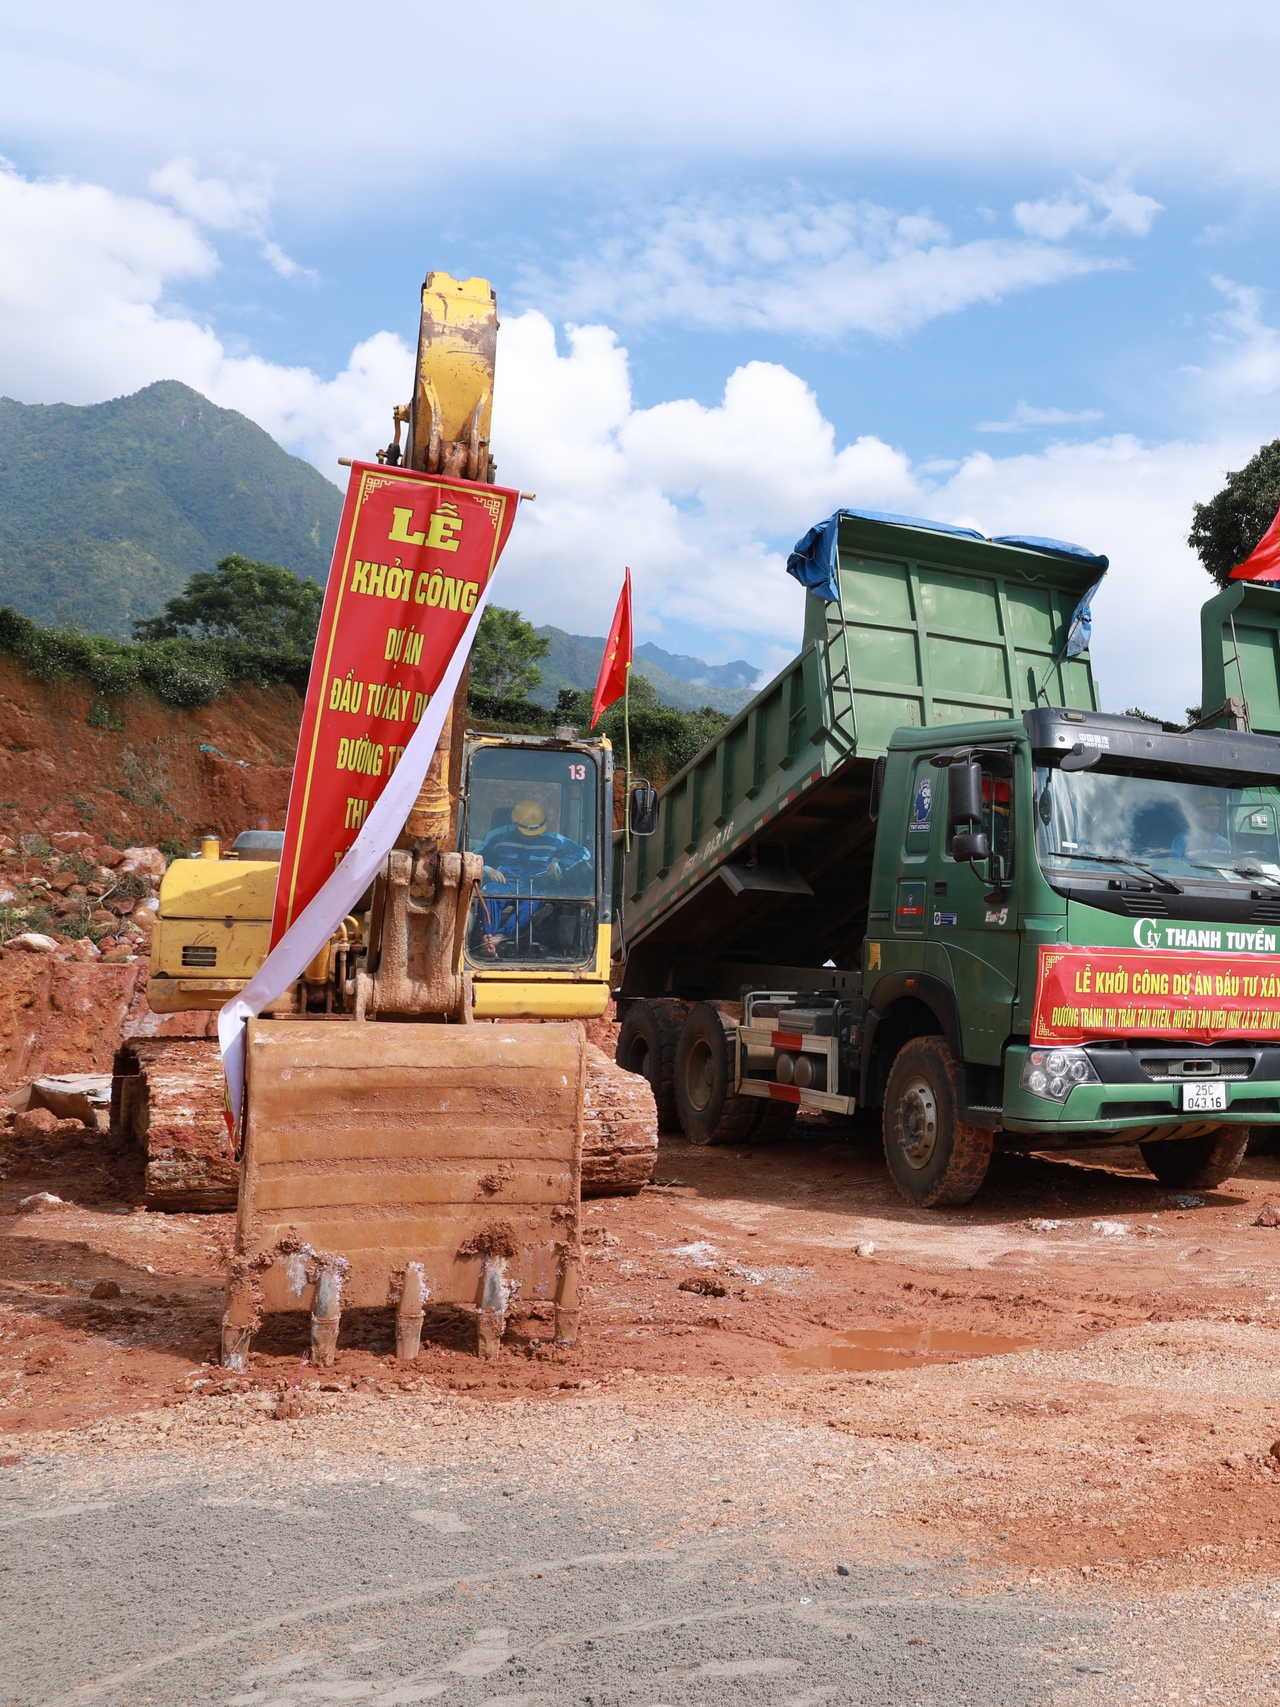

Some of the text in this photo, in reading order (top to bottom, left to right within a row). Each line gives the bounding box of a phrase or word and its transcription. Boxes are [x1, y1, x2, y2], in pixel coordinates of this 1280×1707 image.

[388, 502, 463, 552] LỄ
[350, 557, 479, 614] KHỞI CÔNG
[384, 625, 425, 669] DỰ ÁN
[329, 668, 364, 714] ĐẦU
[366, 682, 387, 718] TƯ
[382, 681, 411, 722] XÂY
[336, 733, 384, 776] ĐƯỜNG
[568, 764, 586, 780] 13
[1133, 918, 1276, 951] Cty THANH TUYỀN
[1075, 963, 1092, 993] LỄ
[1095, 965, 1129, 994] KHỞI
[1132, 969, 1169, 995] CÔNG
[1172, 972, 1193, 1000] DỰ
[1194, 971, 1213, 996] ÁN
[1215, 969, 1240, 997] ĐẦU
[1242, 974, 1259, 998] TƯ
[1051, 1003, 1079, 1028] ĐƯỜNG
[1080, 1004, 1104, 1028] TRÁNH
[1105, 1008, 1117, 1032] THỊ
[1118, 1002, 1137, 1028] TRẤN
[1137, 1005, 1151, 1028] TÂN
[1172, 1006, 1196, 1032] HUYỆN
[1197, 1006, 1210, 1029] TÂN
[1241, 1007, 1251, 1029] LÀ
[1261, 1008, 1272, 1030] TÂN
[1188, 1097, 1222, 1109] 043.16
[1196, 1085, 1214, 1096] 25C
